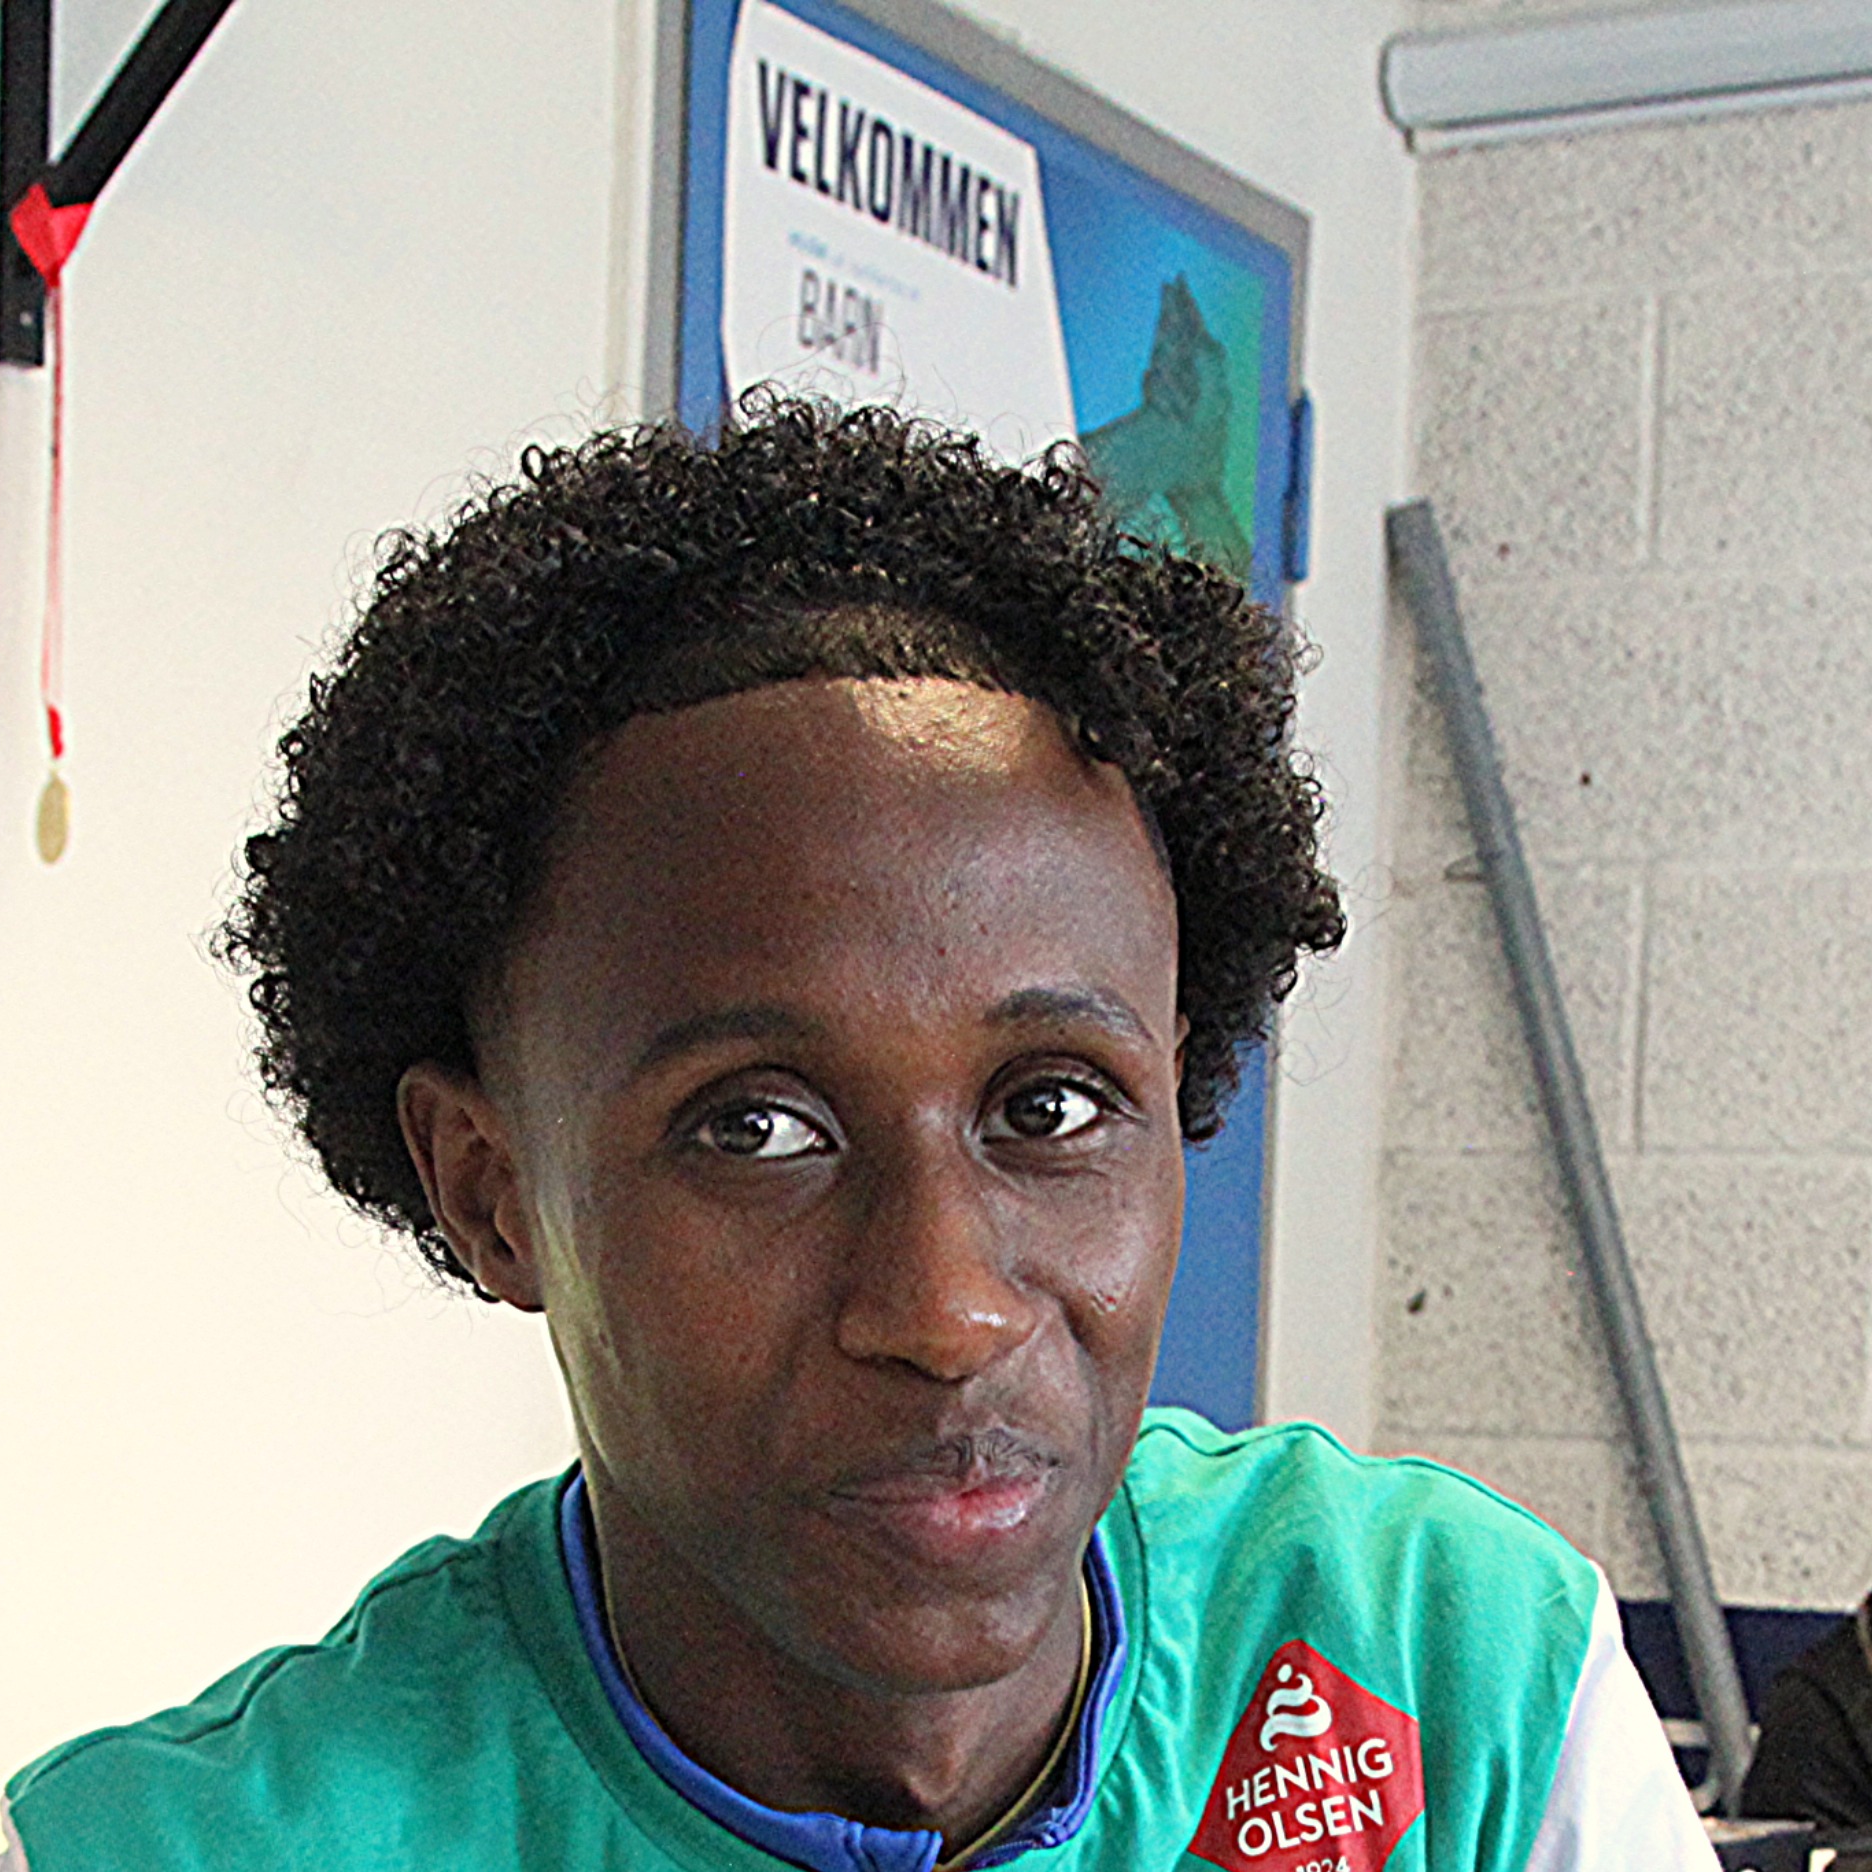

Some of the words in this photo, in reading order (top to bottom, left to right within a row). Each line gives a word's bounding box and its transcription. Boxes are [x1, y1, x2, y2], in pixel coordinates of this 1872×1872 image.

[757, 57, 1021, 290] VELKOMMEN
[796, 268, 885, 374] BARN
[1225, 1738, 1395, 1820] HENNIG
[1237, 1789, 1384, 1857] OLSEN
